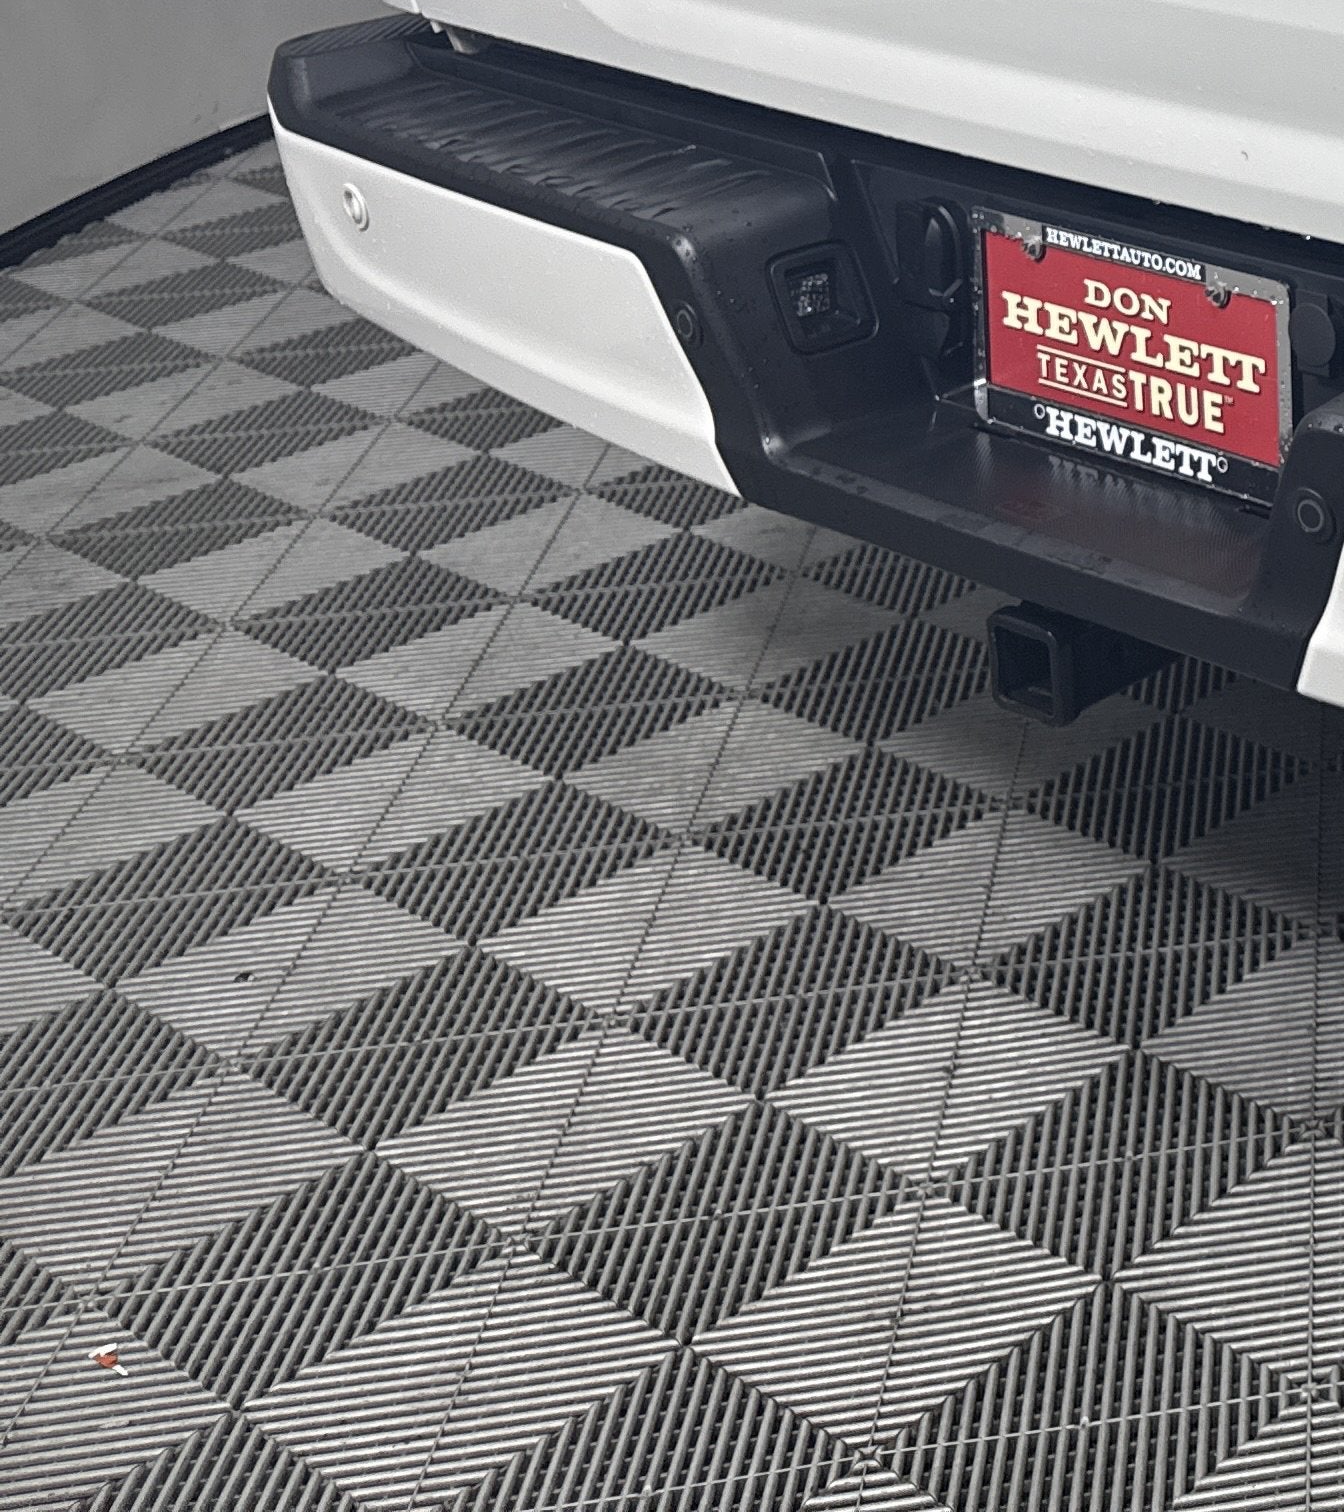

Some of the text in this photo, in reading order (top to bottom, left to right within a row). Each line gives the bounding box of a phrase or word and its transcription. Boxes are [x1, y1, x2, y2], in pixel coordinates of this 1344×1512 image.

[1045, 227, 1202, 280] HEWLETTAUTO.COM
[1083, 278, 1171, 325] DON
[1001, 290, 1266, 394] HEWLETT
[1045, 406, 1216, 483] HEWLETT
